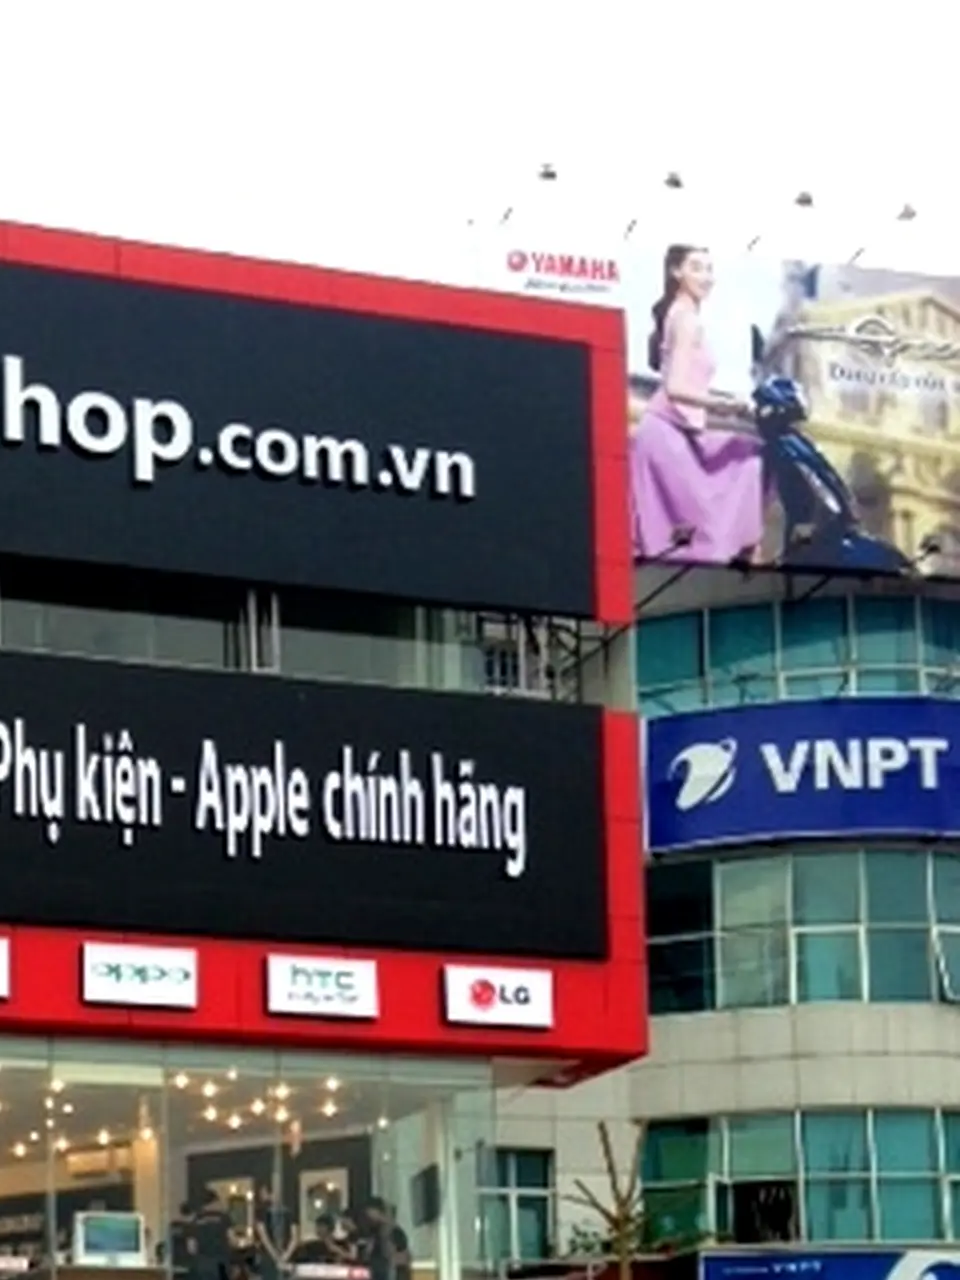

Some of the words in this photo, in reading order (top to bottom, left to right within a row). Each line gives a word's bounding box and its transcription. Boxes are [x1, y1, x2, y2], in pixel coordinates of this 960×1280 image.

[531, 252, 620, 282] YAMAHA
[759, 737, 949, 793] VNPT
[76, 722, 162, 845] kiện
[195, 738, 310, 858] Apple
[323, 745, 425, 844] chính
[433, 753, 525, 877] hãng
